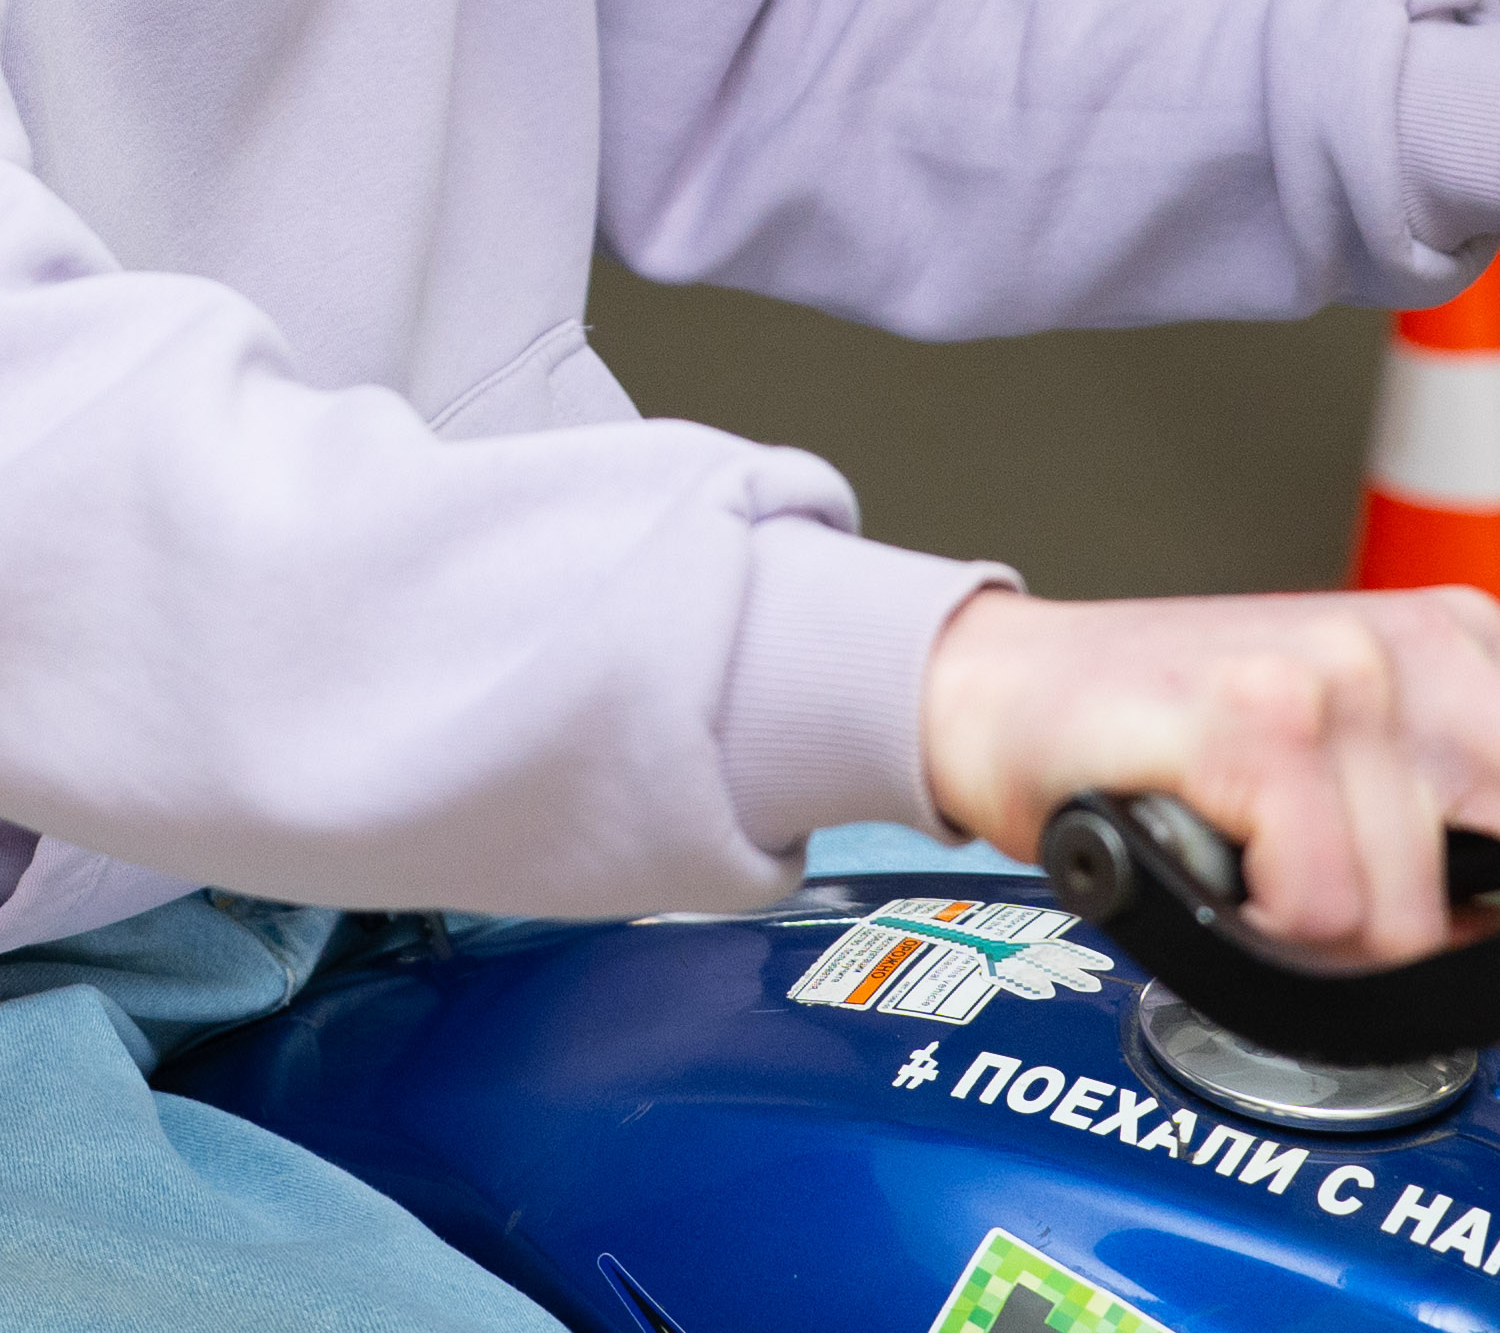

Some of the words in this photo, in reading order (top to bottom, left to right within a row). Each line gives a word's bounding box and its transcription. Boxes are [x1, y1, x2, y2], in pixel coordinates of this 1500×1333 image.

[871, 940, 918, 979] ОРОЖНО
[950, 1051, 1311, 1195] ПОЕХАЛИ
[1317, 1164, 1376, 1216] С
